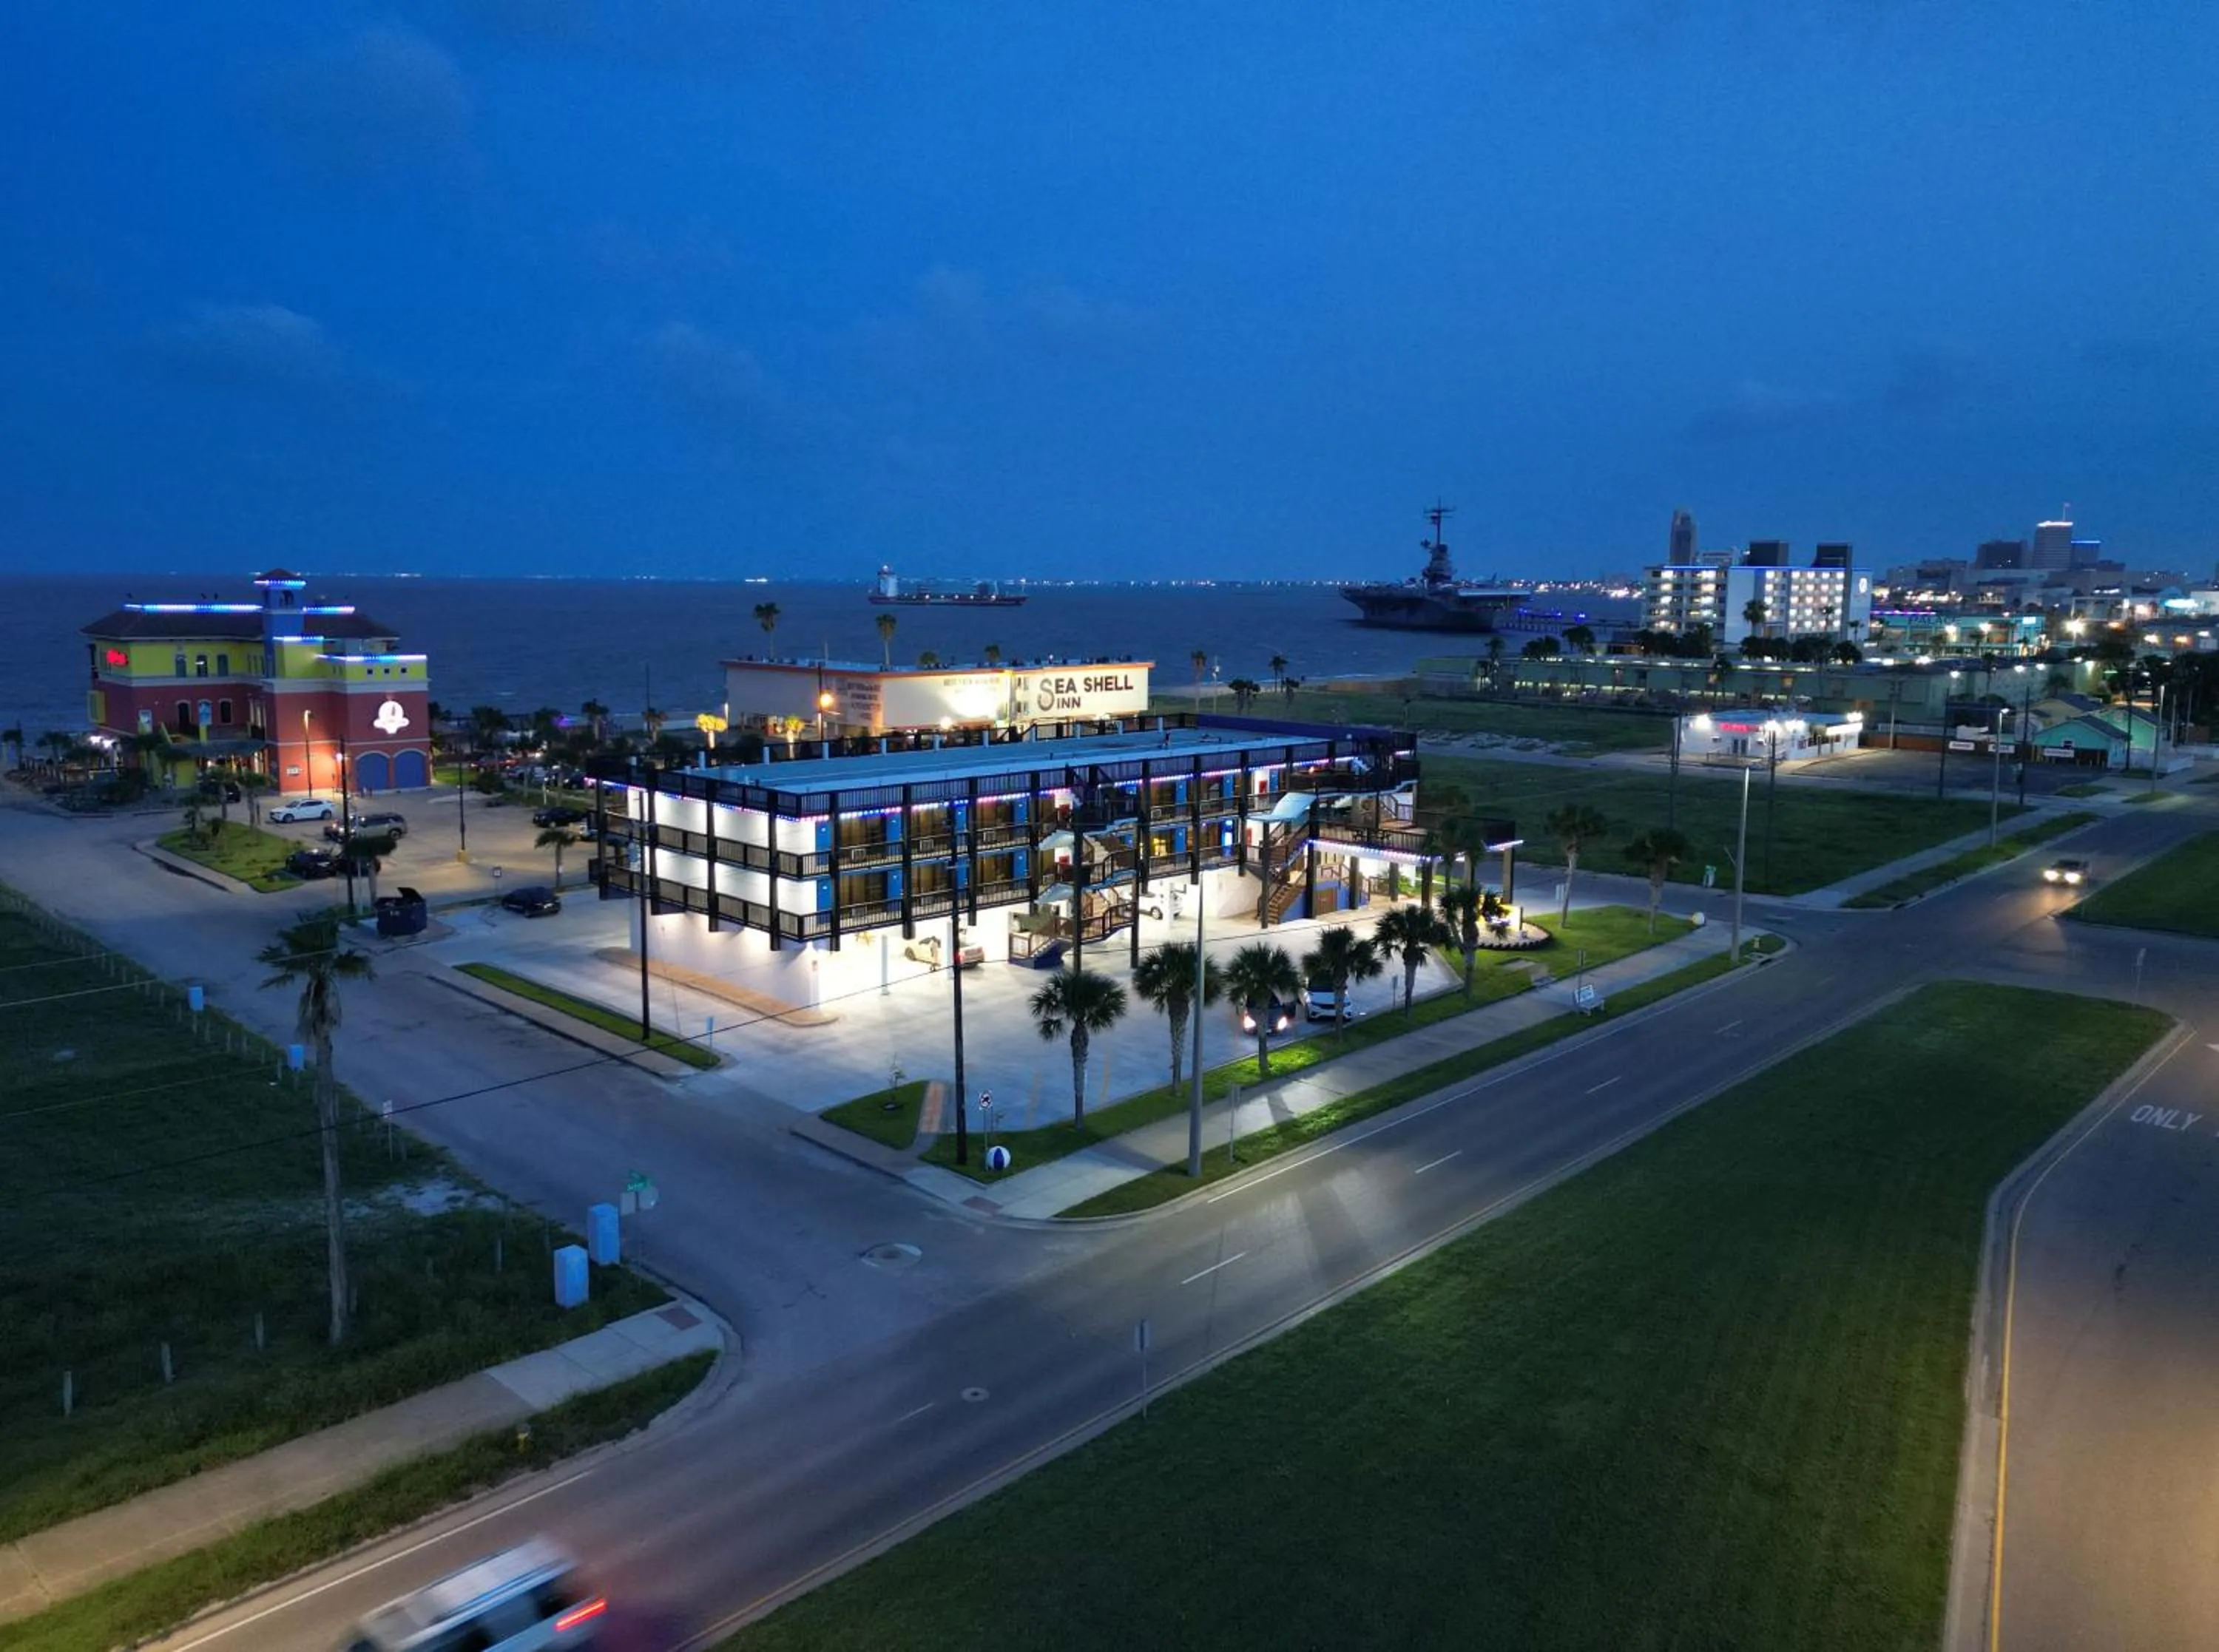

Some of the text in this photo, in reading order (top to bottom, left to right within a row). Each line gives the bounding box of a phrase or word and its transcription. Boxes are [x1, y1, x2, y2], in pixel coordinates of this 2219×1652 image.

[1037, 674, 1133, 711] SEA SHELL
[1057, 696, 1081, 709] INN
[2130, 1105, 2203, 1131] ONLY
